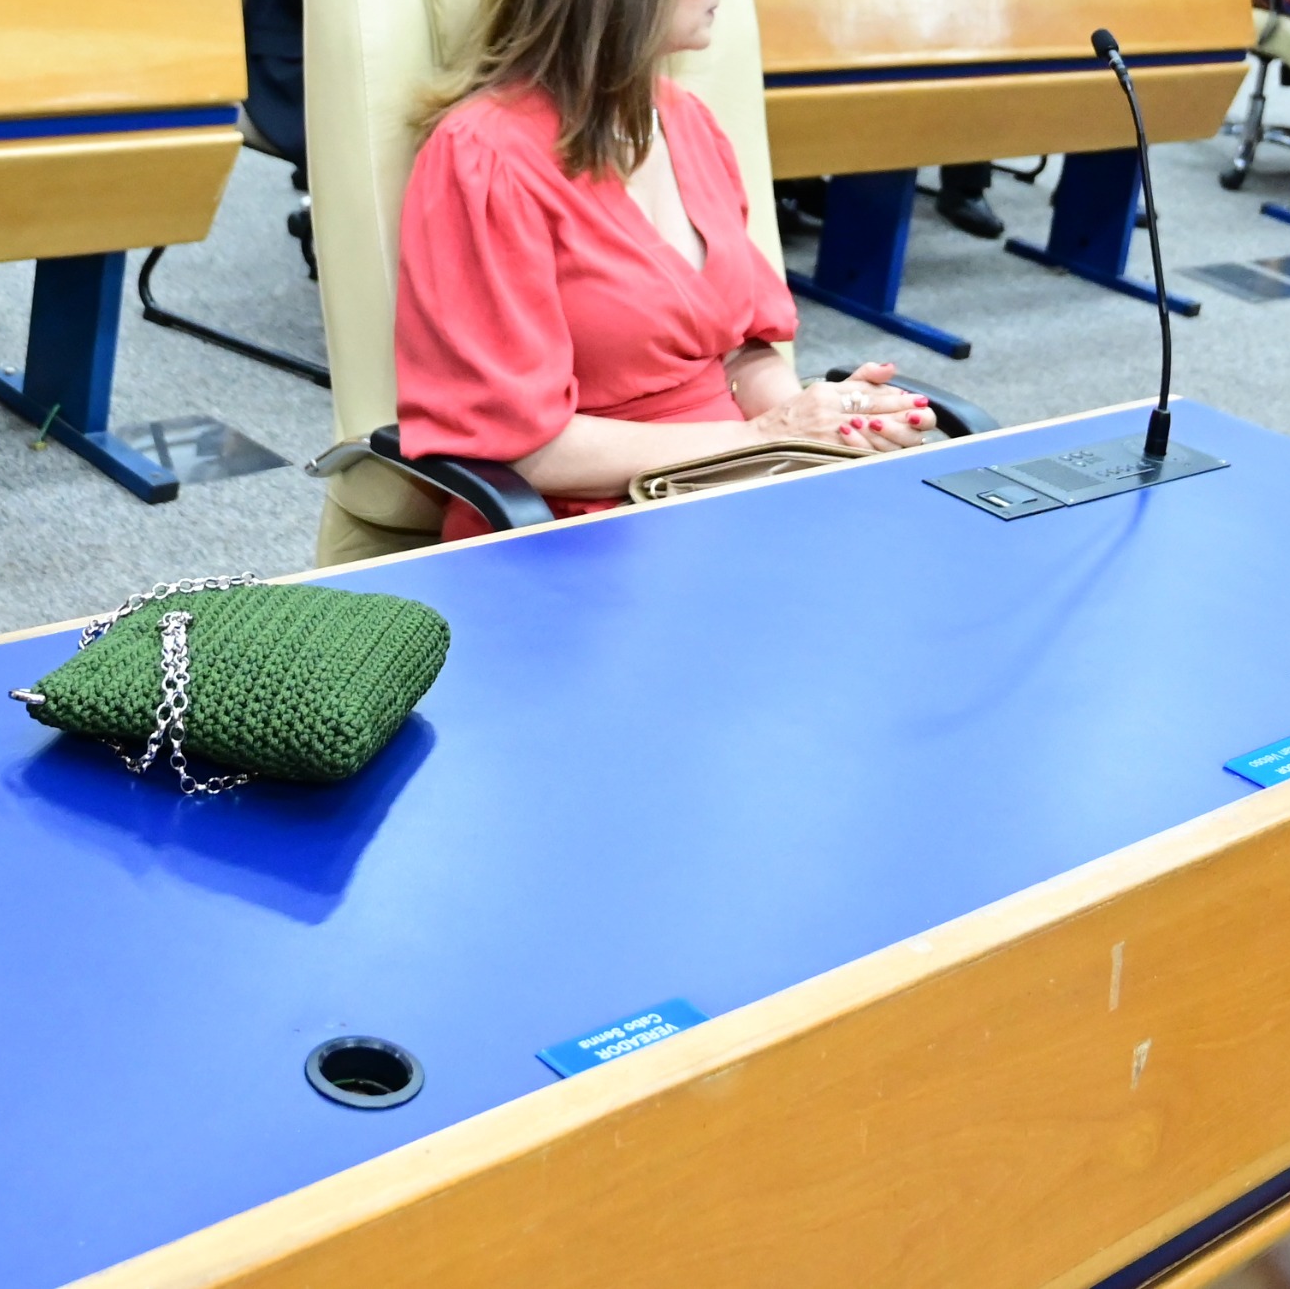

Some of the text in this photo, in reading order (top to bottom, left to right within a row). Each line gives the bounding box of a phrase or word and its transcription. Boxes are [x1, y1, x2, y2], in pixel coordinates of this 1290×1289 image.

[578, 1013, 662, 1049] Cabo Senna
[594, 1022, 679, 1060] VEREADOR
